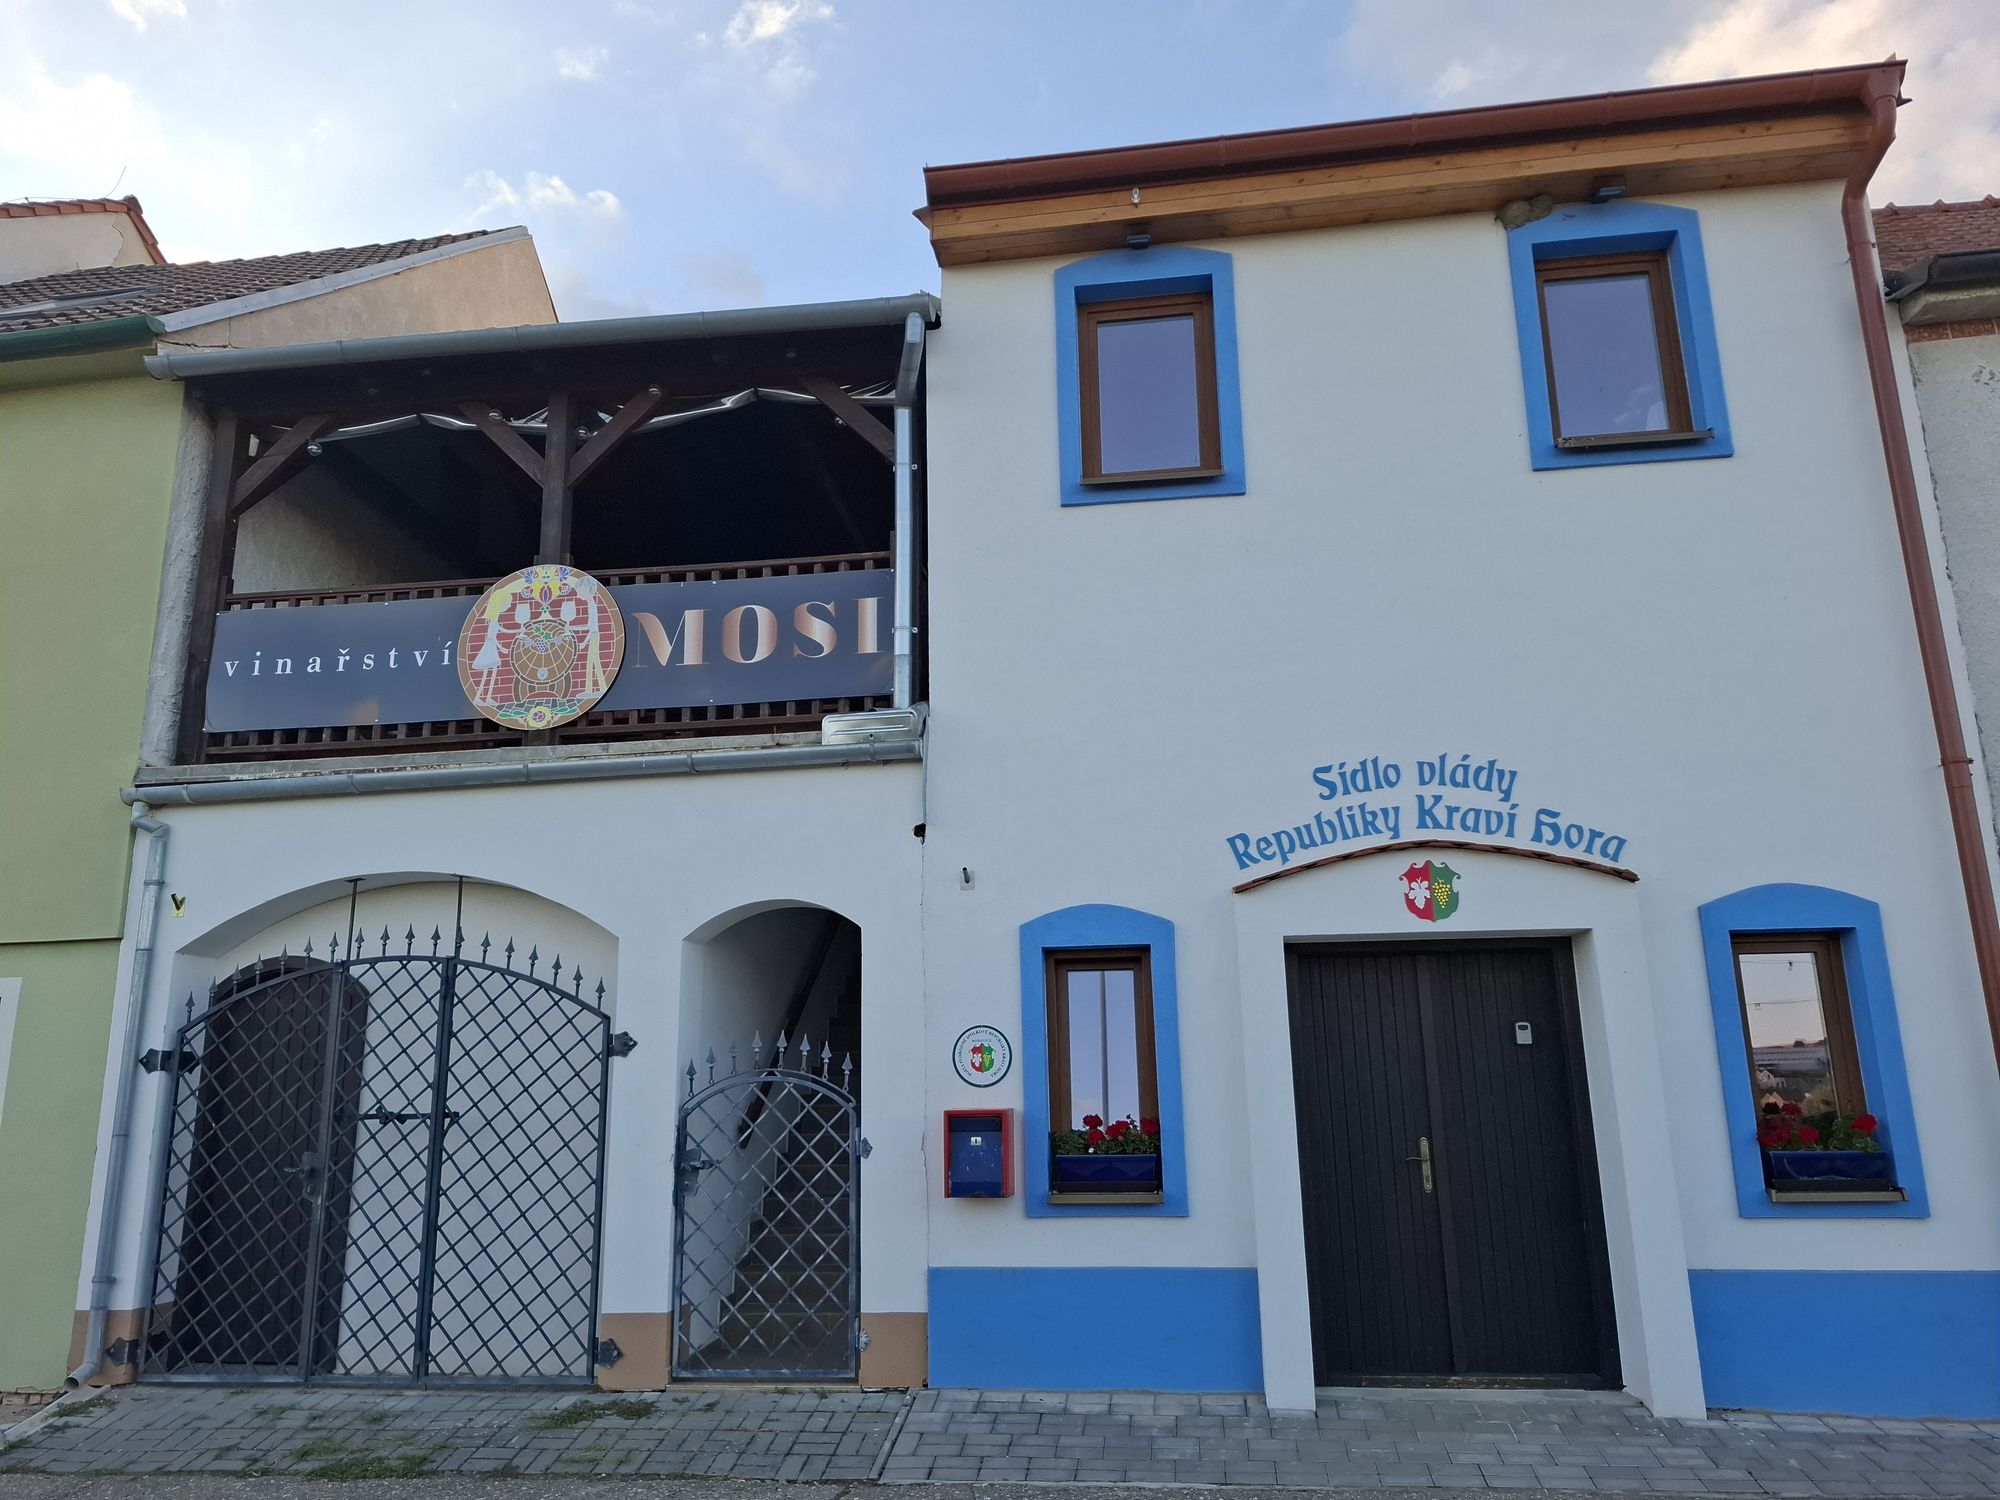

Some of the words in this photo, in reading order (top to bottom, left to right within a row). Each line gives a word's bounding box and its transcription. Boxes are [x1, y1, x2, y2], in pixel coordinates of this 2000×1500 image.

[223, 640, 454, 678] vinařství
[631, 596, 888, 669] MOSI
[1312, 756, 1401, 801] Sídlo
[1416, 752, 1518, 803] vlády
[1226, 802, 1401, 871] Republiky
[1415, 794, 1520, 839] Kraví
[1530, 807, 1628, 864] Hora
